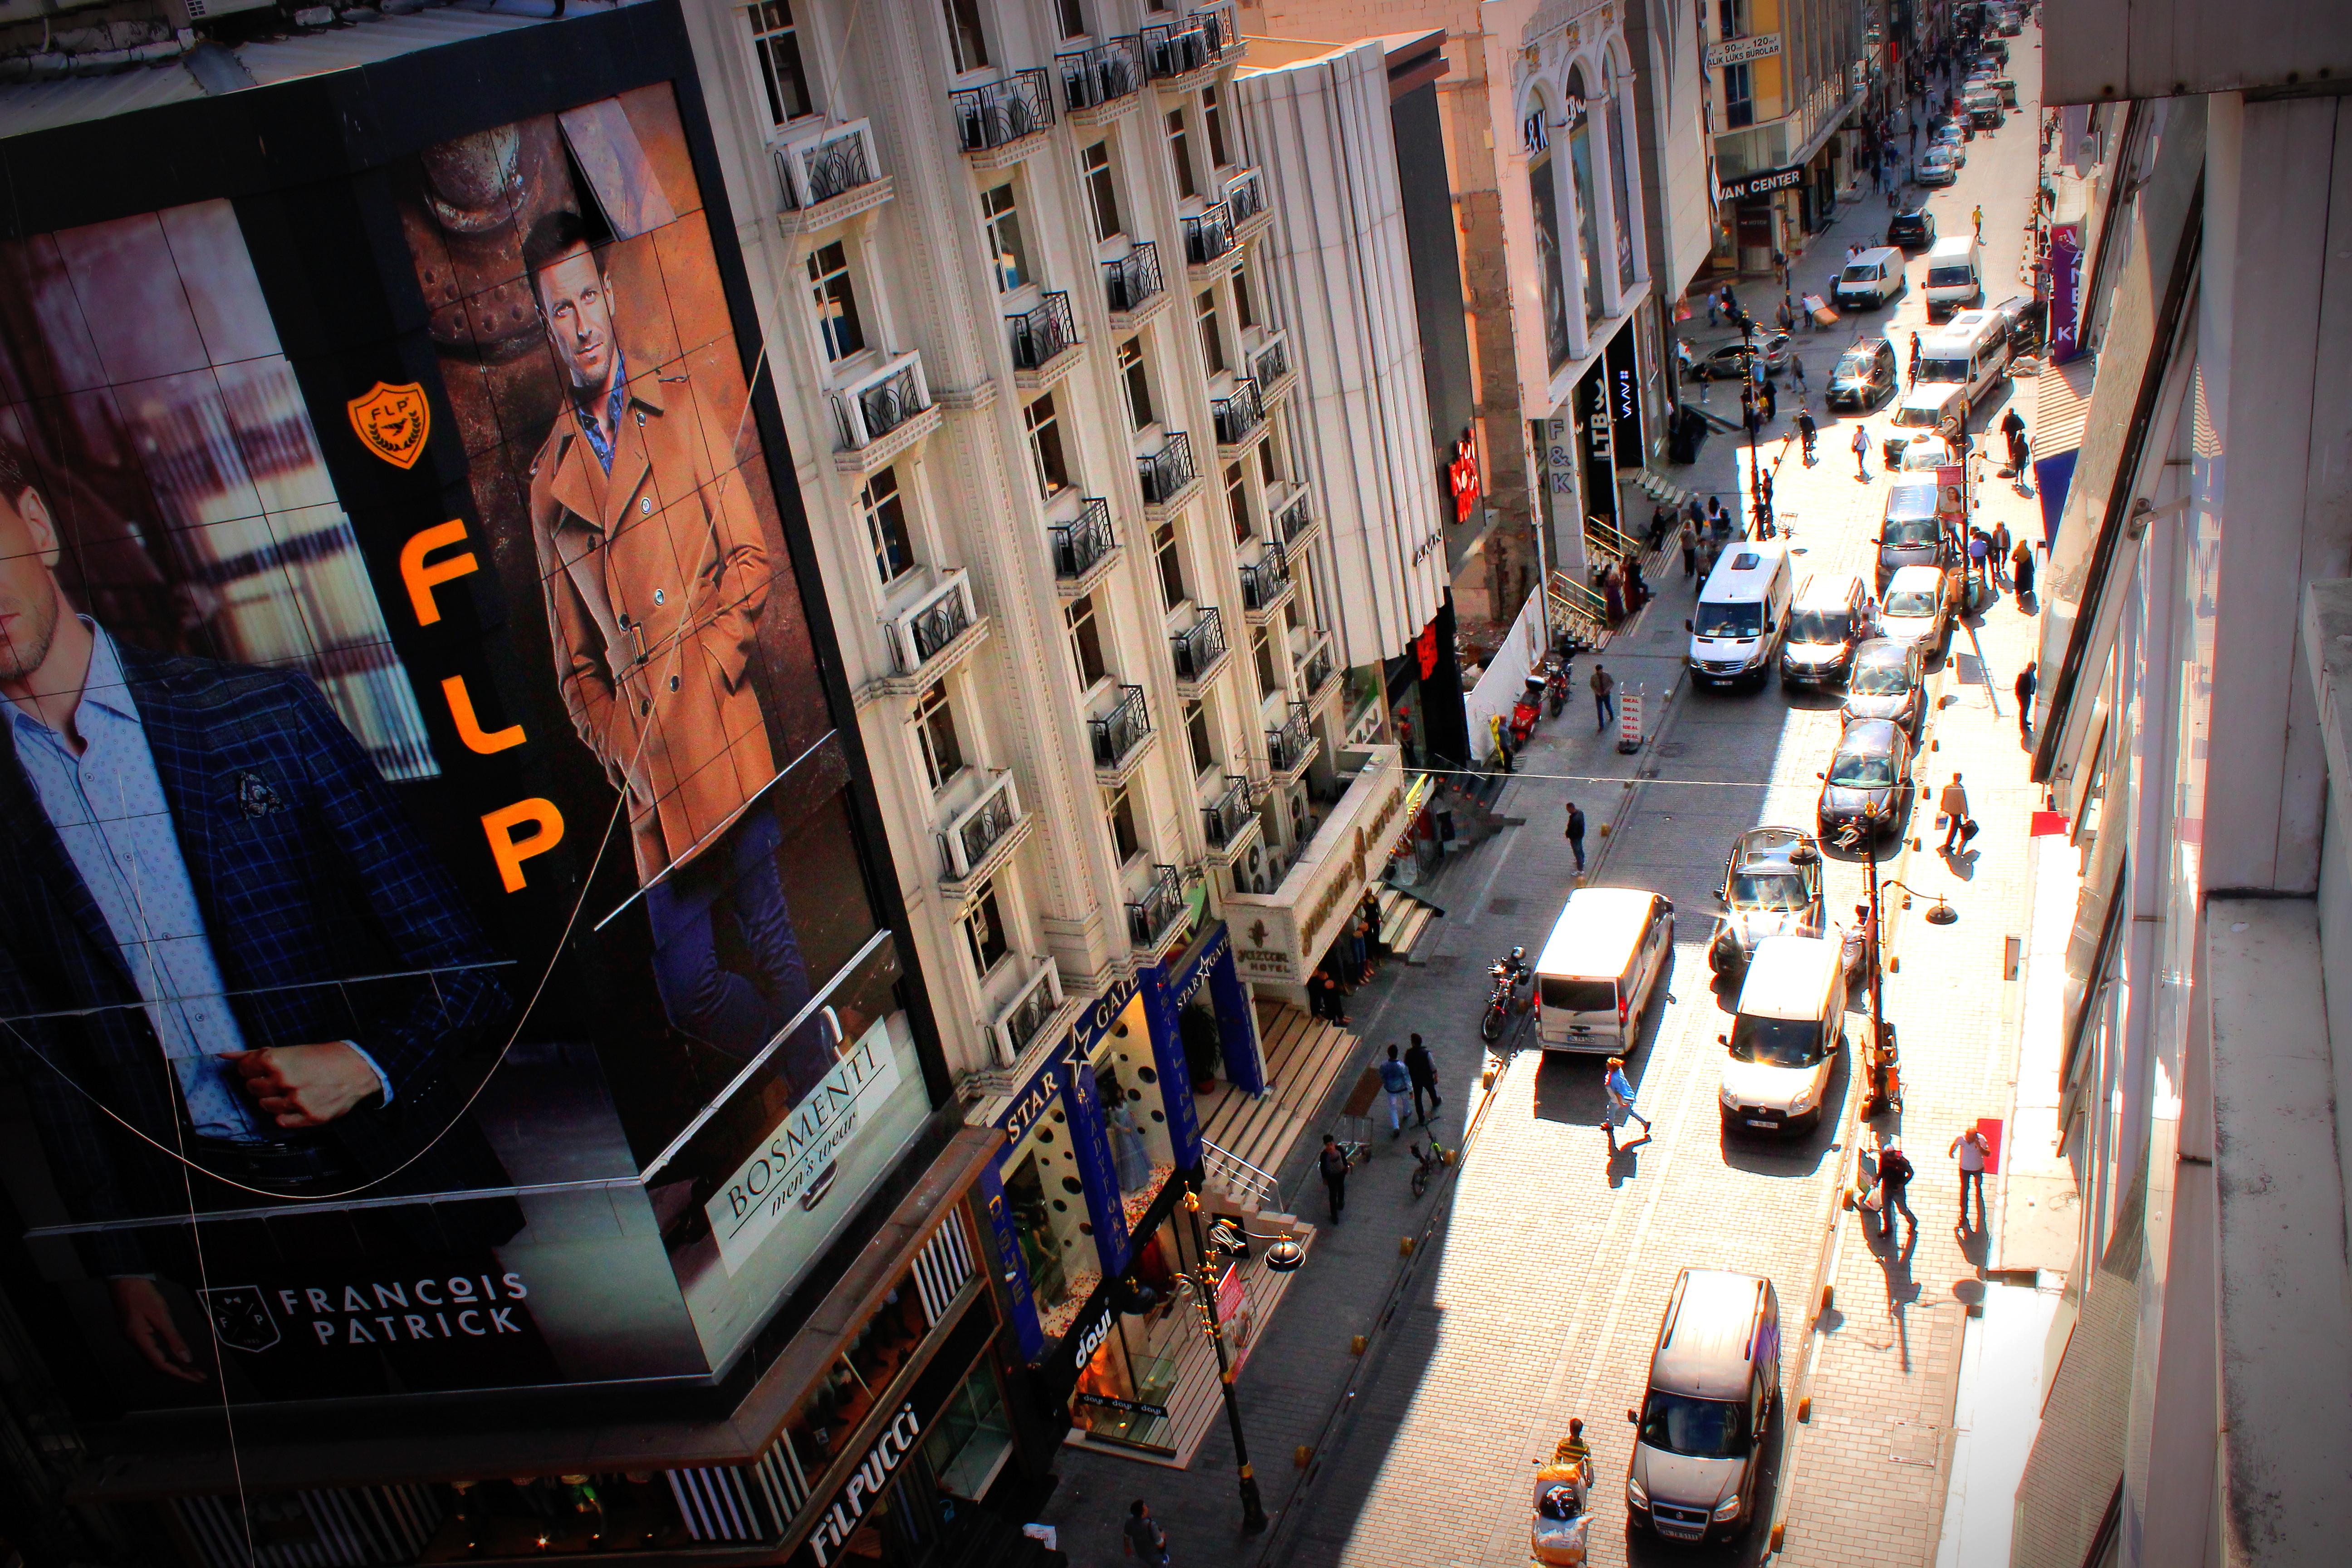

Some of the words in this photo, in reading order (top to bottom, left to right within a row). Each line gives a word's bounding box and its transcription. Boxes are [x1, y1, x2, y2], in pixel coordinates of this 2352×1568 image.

[1725, 53, 1744, 63] LÜKS
[1746, 45, 1779, 58] BÜROLAR
[1750, 171, 1800, 192] CENTER
[372, 400, 407, 420] FLP
[1591, 413, 1610, 458] LTB
[400, 517, 565, 894] FLP
[1251, 963, 1290, 973] HOTEL
[1177, 978, 1198, 1011] STAR
[1007, 1072, 1058, 1144] STAR
[1097, 973, 1139, 1028] GATE
[726, 1042, 878, 1221] BOSMENTI
[772, 1156, 813, 1216] men's
[818, 1111, 857, 1163] wear
[313, 1307, 521, 1346] PATRICK
